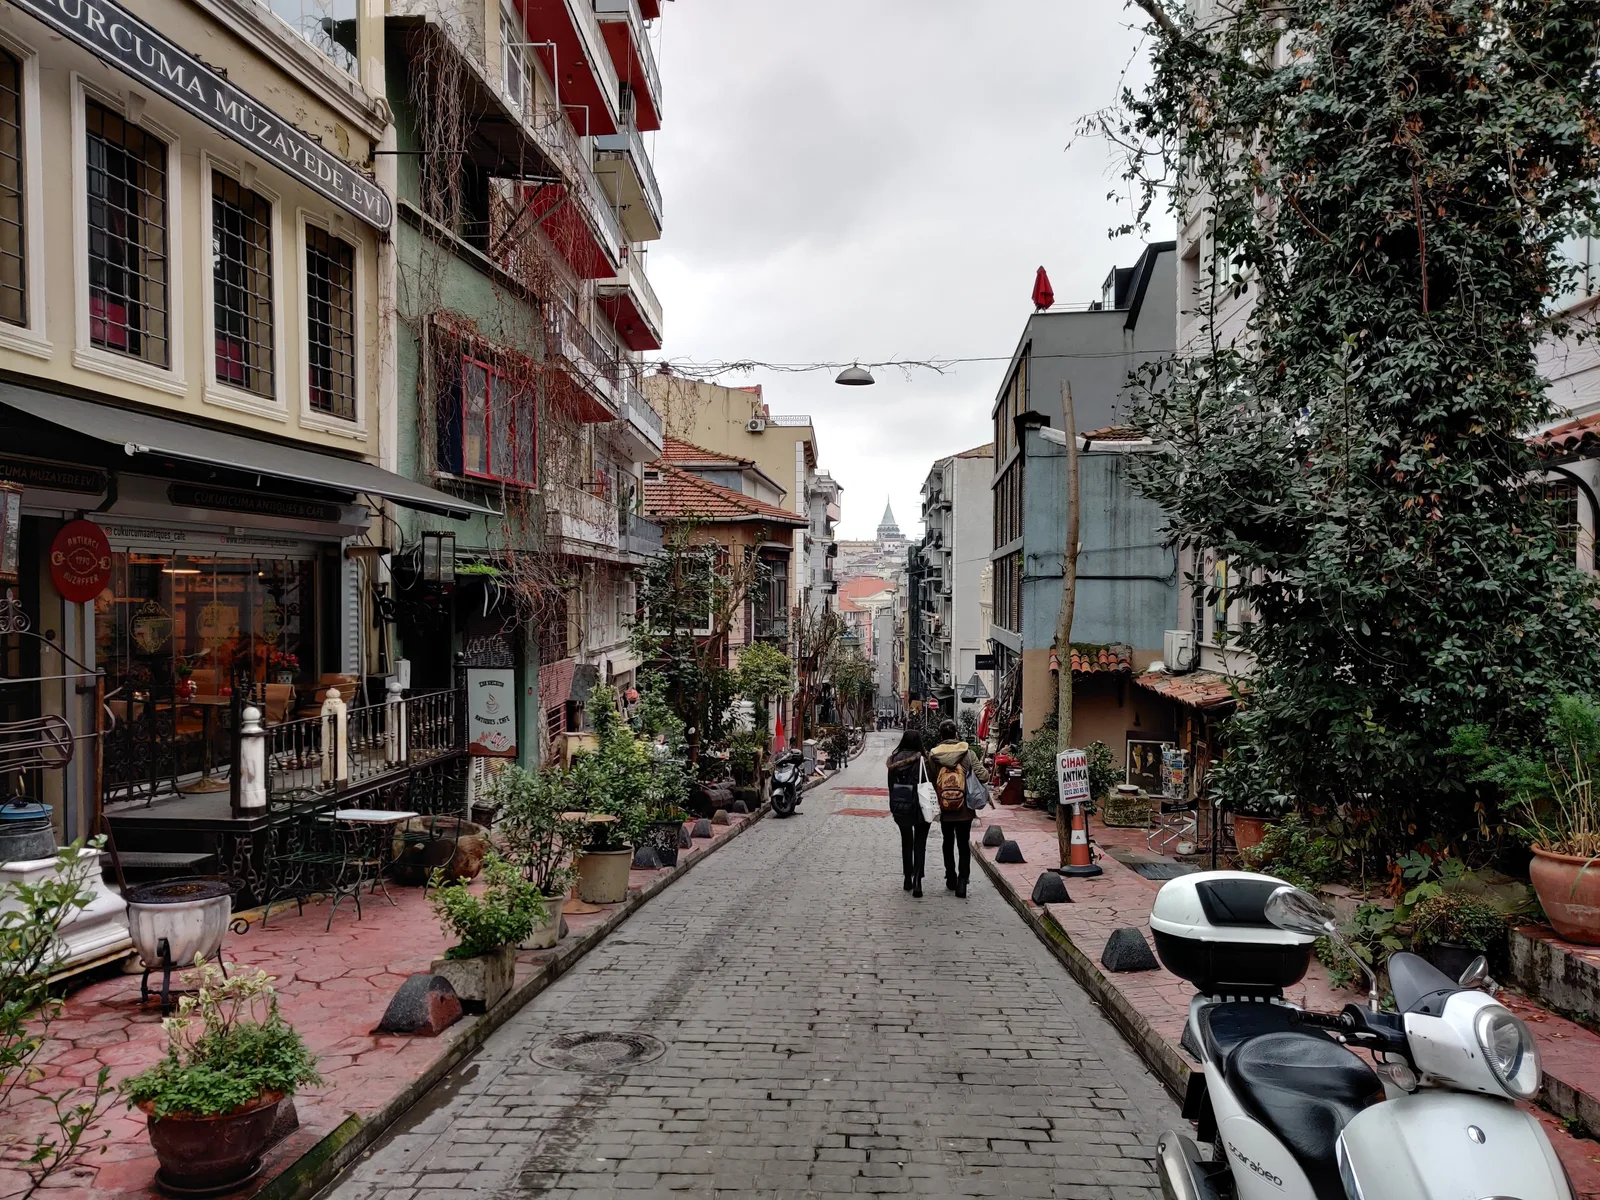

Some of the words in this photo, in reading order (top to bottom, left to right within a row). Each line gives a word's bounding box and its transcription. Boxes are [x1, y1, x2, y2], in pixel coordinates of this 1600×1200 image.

[45, 0, 206, 102] URCUMA
[213, 88, 345, 192] MÜZAYEDE
[350, 183, 384, 219] EVİ
[256, 499, 297, 514] ANTIQUES
[1061, 756, 1087, 768] CİHAN
[1063, 768, 1088, 783] ANTİKA
[1228, 1141, 1283, 1187] scarabeo
